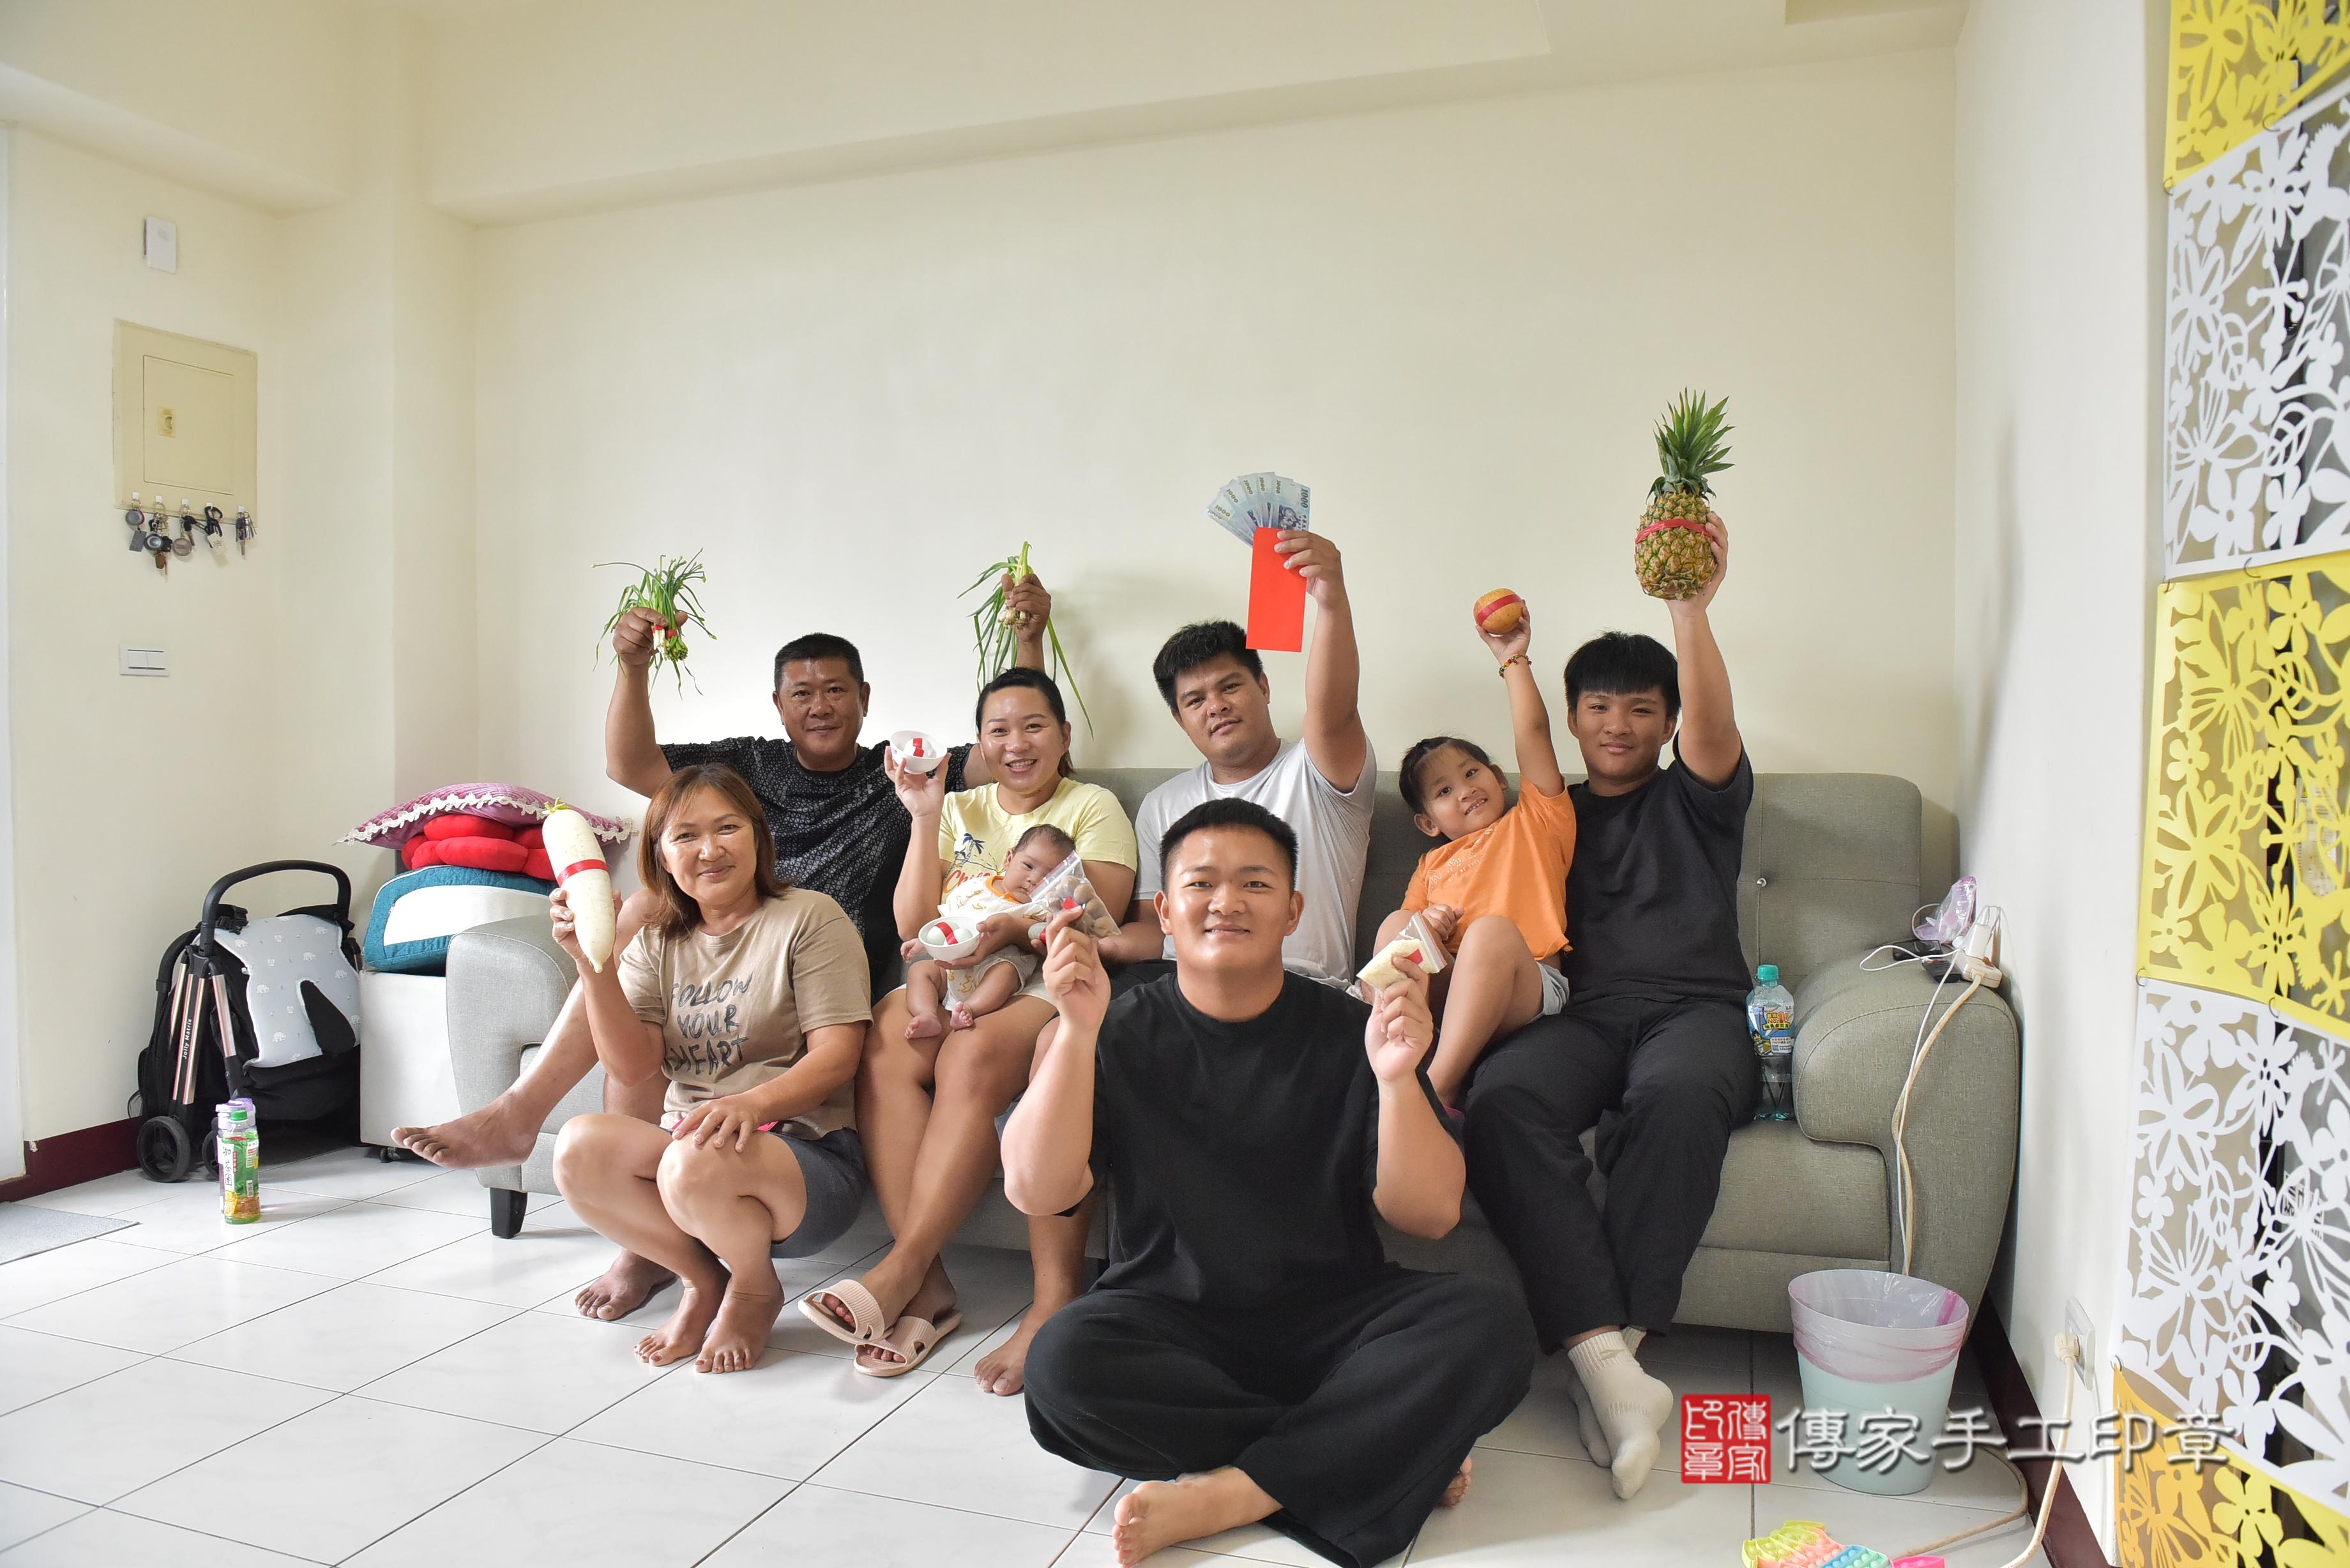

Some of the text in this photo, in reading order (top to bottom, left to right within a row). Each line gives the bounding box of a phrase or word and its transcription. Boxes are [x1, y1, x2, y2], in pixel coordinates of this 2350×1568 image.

[1226, 488, 1239, 503] 1000
[1244, 480, 1253, 495] 1000
[1300, 488, 1308, 508] 1000
[1215, 504, 1231, 517] 1000
[678, 1004, 739, 1038] YOUR
[671, 1036, 748, 1075] HEART
